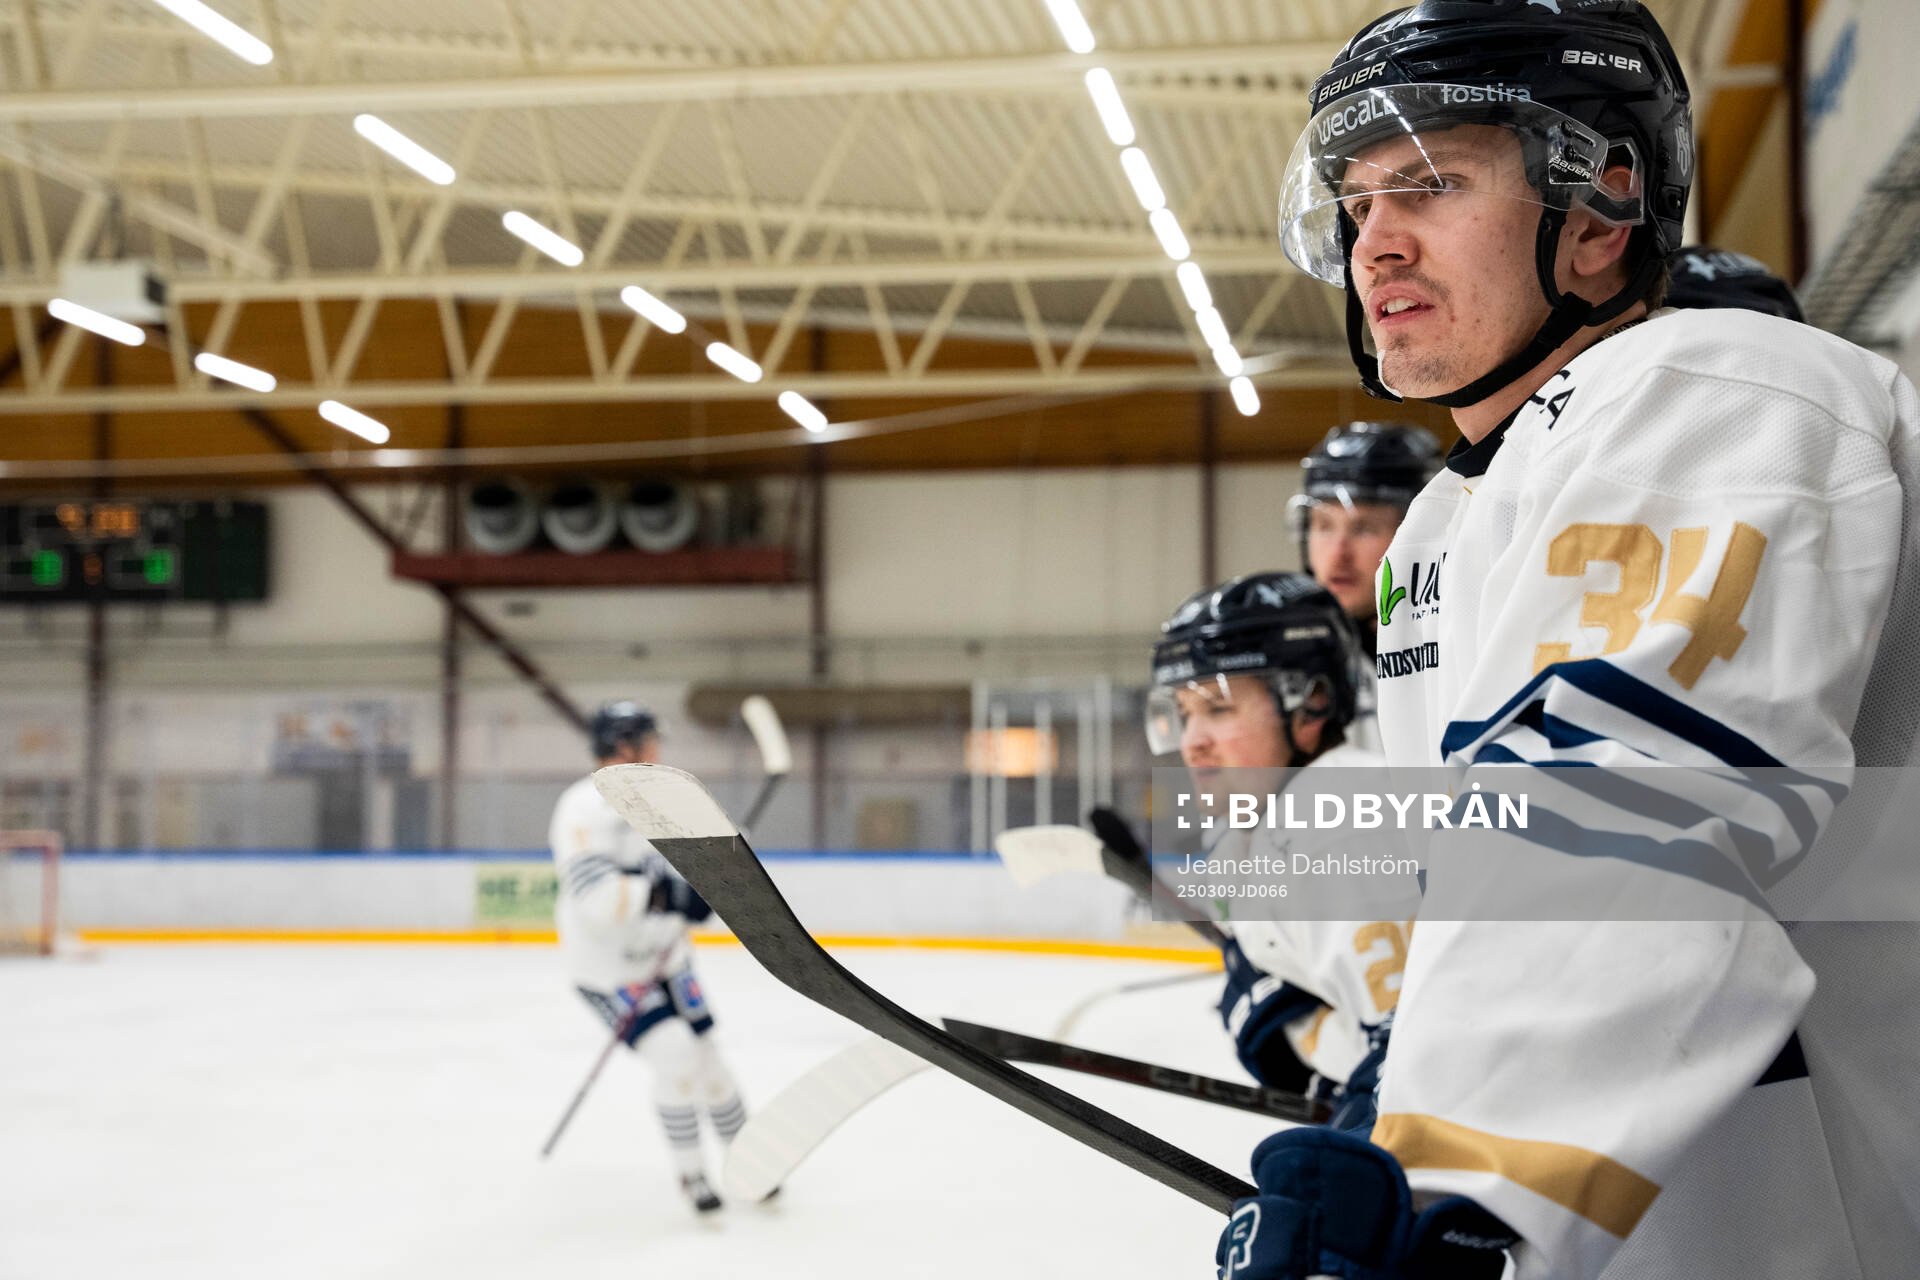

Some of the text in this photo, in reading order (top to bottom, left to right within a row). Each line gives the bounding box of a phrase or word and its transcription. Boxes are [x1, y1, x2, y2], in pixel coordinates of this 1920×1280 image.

[1318, 61, 1387, 104] BAUER
[1440, 82, 1532, 105] fostira
[1550, 154, 1592, 180] BAUER
[1532, 520, 1768, 692] 34
[1353, 912, 1417, 1014] 2
